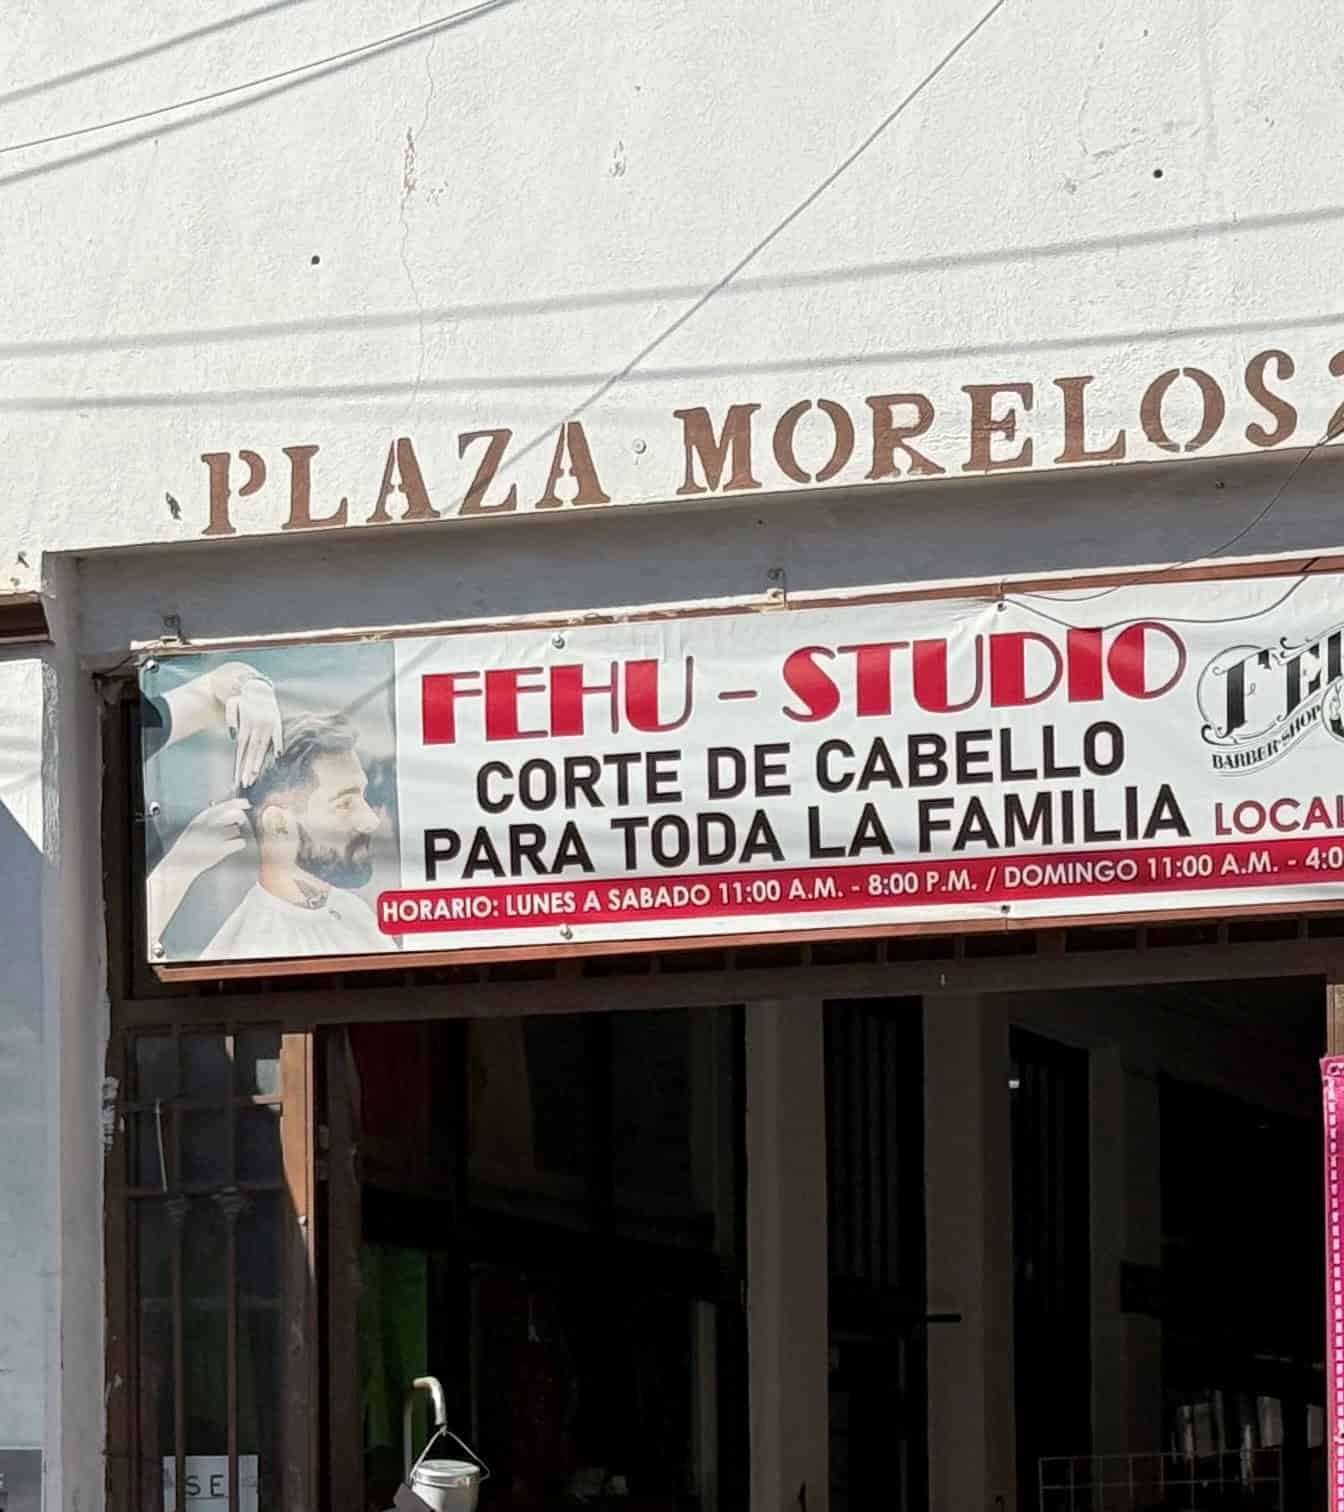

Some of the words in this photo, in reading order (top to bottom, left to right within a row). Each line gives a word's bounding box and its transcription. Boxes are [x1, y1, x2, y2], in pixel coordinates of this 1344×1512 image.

[201, 420, 610, 535] PLAZA
[674, 349, 1297, 495] MORELOS
[421, 656, 694, 746] FEHU
[781, 620, 1187, 722] STUDIO
[477, 750, 683, 814] CORTE
[707, 742, 792, 800] DE
[815, 720, 1125, 792] CABELLO
[1212, 739, 1278, 770] BARBER
[424, 820, 595, 882] PARA
[610, 808, 785, 870] TODA
[808, 803, 894, 858] LA
[918, 784, 1191, 853] FAMILIA
[382, 894, 499, 923] HORARIO:
[506, 892, 576, 917] LUNES
[583, 891, 602, 912] A
[608, 883, 710, 910] SABADO
[718, 880, 781, 905] 11:00
[788, 877, 844, 901] A.M.
[868, 871, 919, 896] 8:00
[925, 868, 978, 895] P.M.
[1004, 859, 1139, 888] DOMINGO
[1146, 853, 1213, 880] 11:00
[1221, 850, 1279, 876] A.M.
[184, 1474, 225, 1498] SE
